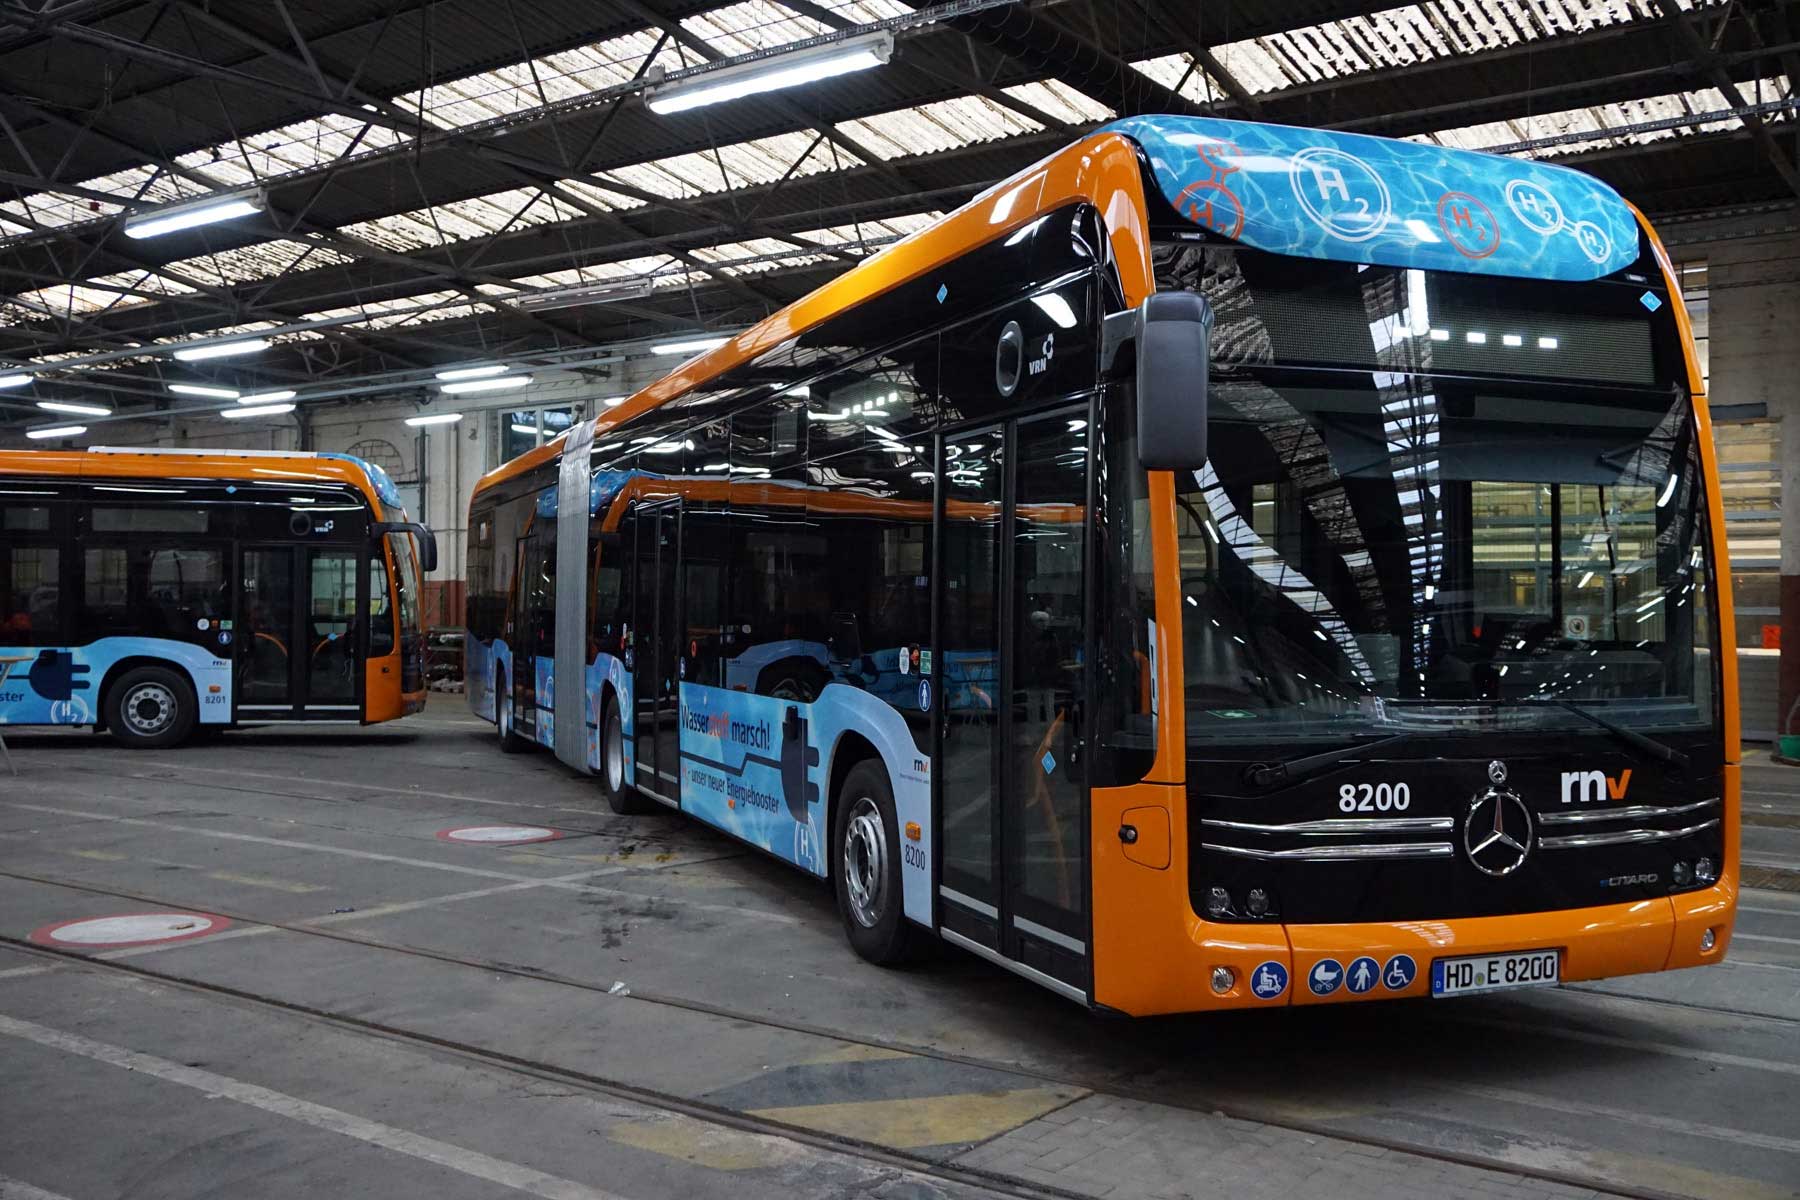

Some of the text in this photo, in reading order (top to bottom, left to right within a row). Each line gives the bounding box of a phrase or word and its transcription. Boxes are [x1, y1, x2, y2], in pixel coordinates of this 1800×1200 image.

[1311, 164, 1370, 217] H2
[1517, 190, 1553, 224] H2
[1452, 205, 1487, 241] H2
[1582, 229, 1605, 257] H2
[1029, 357, 1047, 375] VRN
[204, 695, 226, 705] 8201
[681, 703, 770, 751] Wasserstoff marsch!
[726, 777, 779, 814] Energiebooster
[1338, 782, 1411, 813] 8200
[1560, 768, 1633, 803] rnv
[905, 843, 926, 872] 8200
[1446, 962, 1473, 989] HD
[1487, 960, 1500, 985] E
[1504, 955, 1555, 983] 8200
